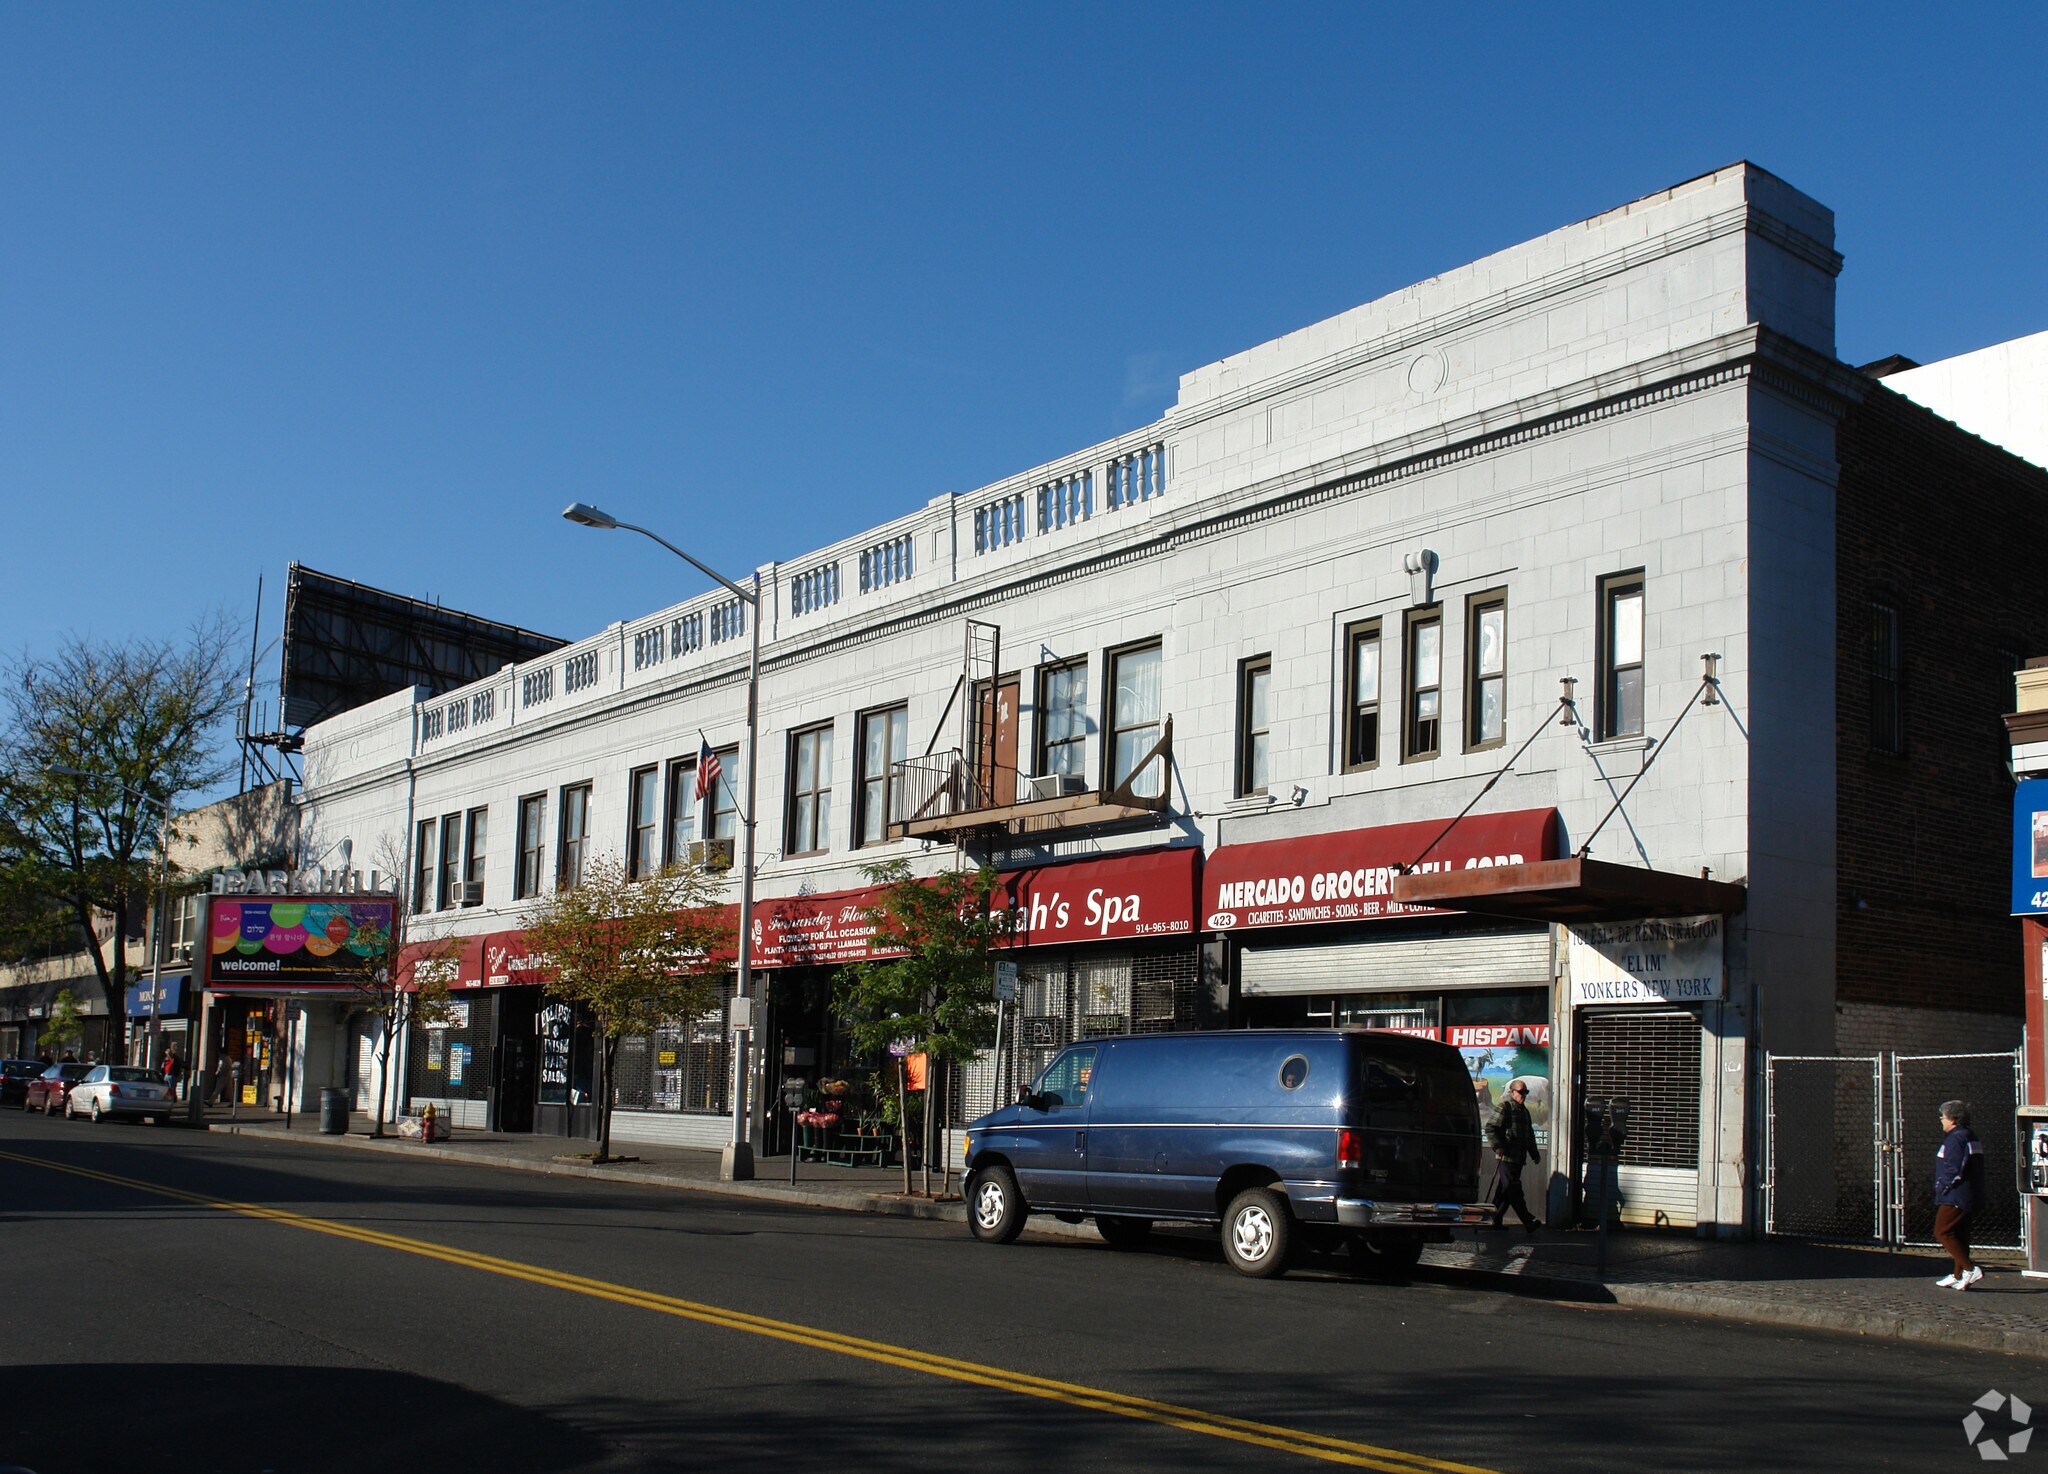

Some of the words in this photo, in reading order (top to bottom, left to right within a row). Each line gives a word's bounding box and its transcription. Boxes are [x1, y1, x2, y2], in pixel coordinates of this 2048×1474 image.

[1218, 875, 1305, 910] MERCADO
[1310, 866, 1401, 902] GROCERY
[767, 911, 833, 931] Fernandez
[1084, 888, 1141, 936] Spa
[1213, 915, 1232, 926] 423
[1247, 909, 1284, 925] CIGARETTES
[1288, 903, 1331, 922] SANDWICHES
[1335, 902, 1358, 918] SODAS
[1363, 900, 1380, 916] BEER
[779, 933, 809, 943] FLOWERS
[810, 932, 824, 940] FOR
[826, 930, 838, 939] ALL
[840, 926, 876, 937] OCCASION
[1135, 919, 1189, 934] 914-965-8010
[1573, 927, 1614, 946] IGLESIA
[1618, 925, 1630, 943] DE
[764, 946, 784, 954] PLANTS
[837, 938, 867, 948] LLAMADAS
[221, 959, 280, 971] welcome!
[1621, 953, 1667, 972] "ELIM"
[1581, 980, 1638, 999] YONKERS
[1643, 979, 1671, 998] NEW
[1677, 978, 1712, 996] YORK
[541, 1003, 571, 1028] ECLIPSE
[1452, 1027, 1549, 1046] HISPANA
[542, 1069, 567, 1084] SALON
